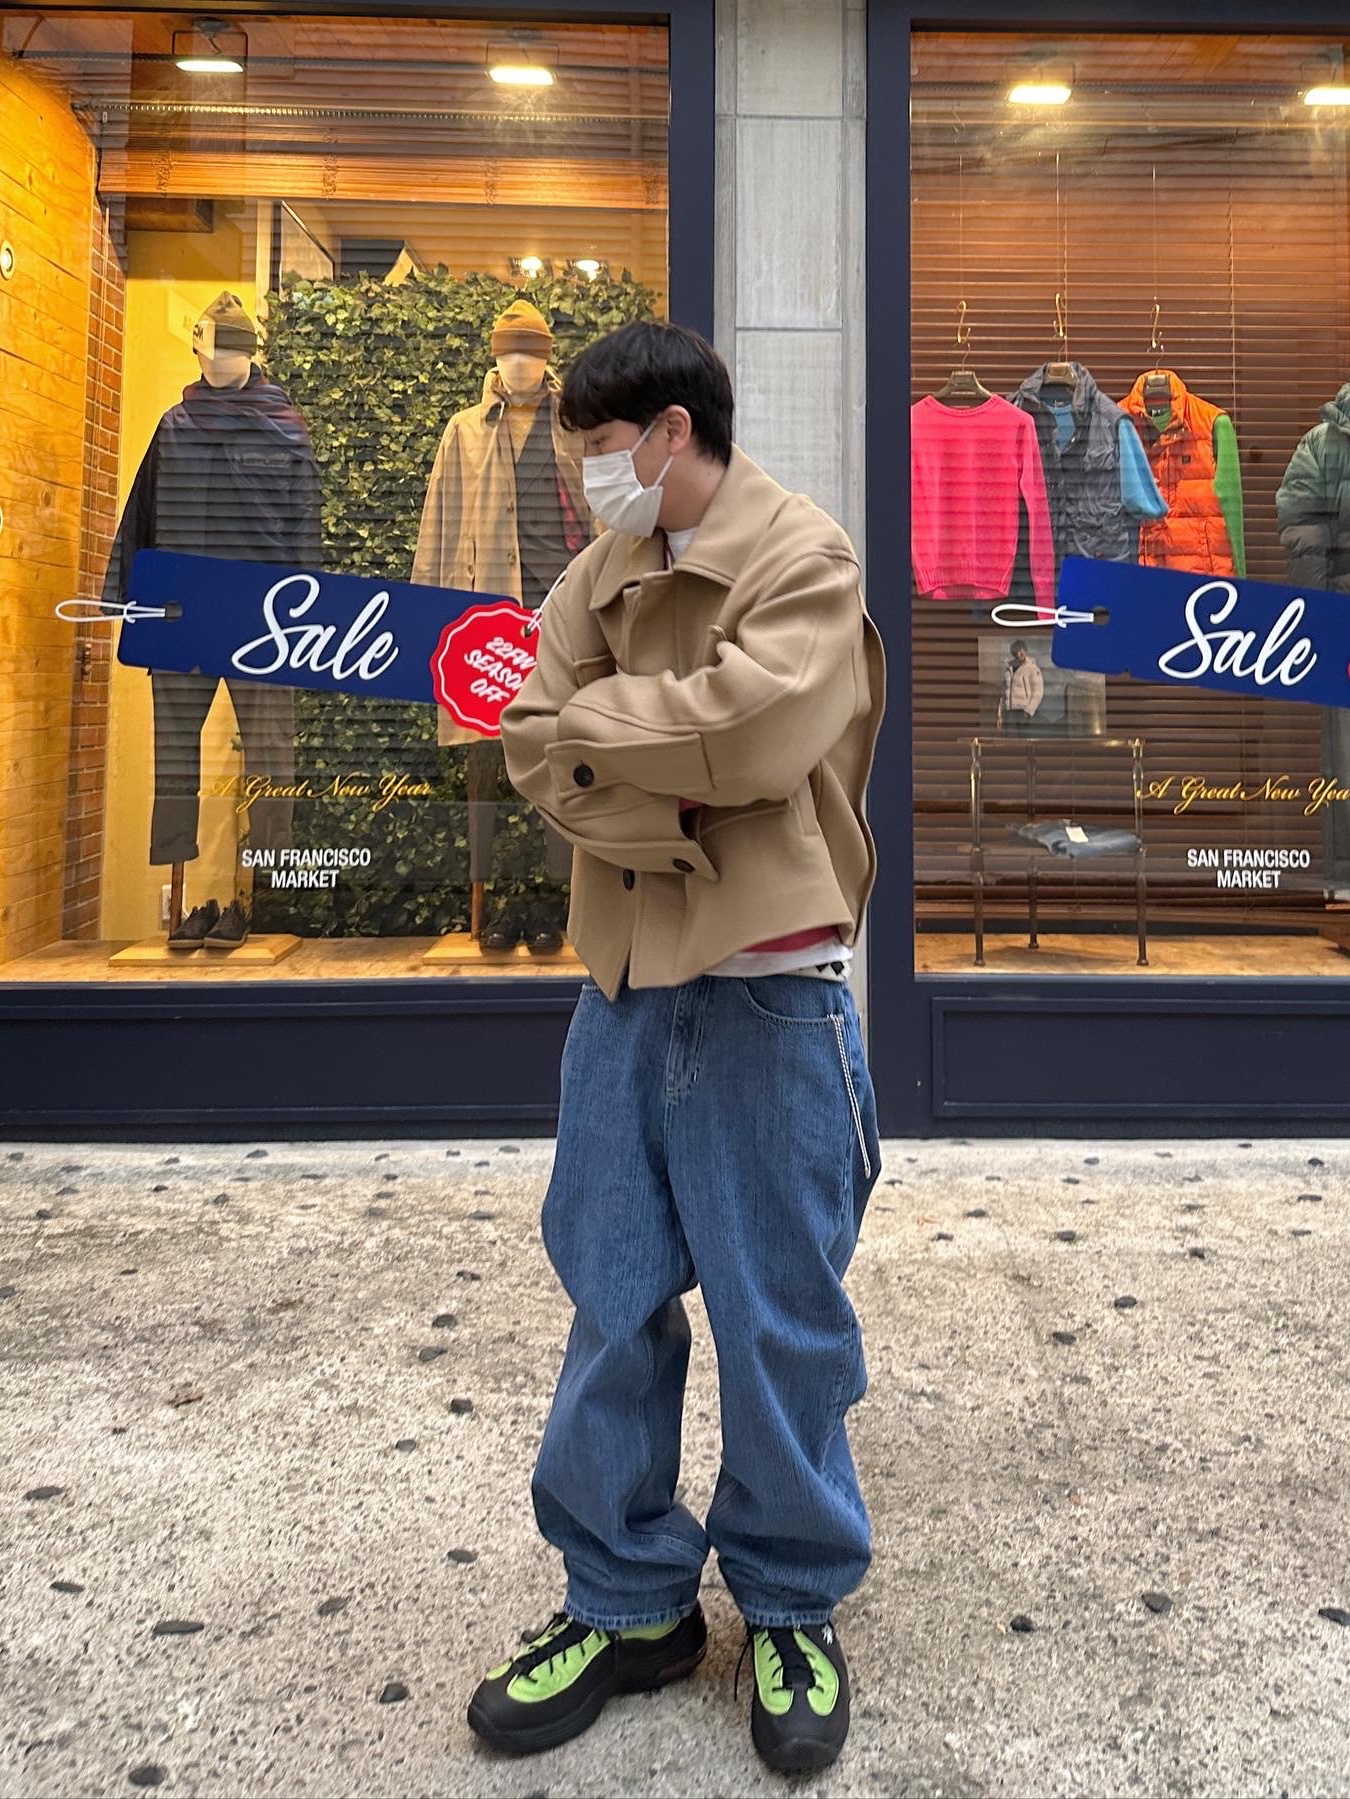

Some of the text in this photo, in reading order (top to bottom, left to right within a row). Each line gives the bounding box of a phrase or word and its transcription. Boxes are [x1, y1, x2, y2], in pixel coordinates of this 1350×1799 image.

[231, 573, 399, 681] Sale
[1158, 580, 1318, 686] Sale
[464, 649, 522, 691] SEASO
[470, 678, 510, 703] OFF
[236, 775, 310, 813] Great
[307, 771, 372, 798] New
[372, 773, 432, 812] Year
[1136, 775, 1350, 816] A Great New Yea
[242, 848, 371, 867] SAN FRANCISCO
[1187, 849, 1311, 869] SAN FRANCISCO
[271, 870, 340, 888] MARKET
[1217, 870, 1281, 889] MARKET
